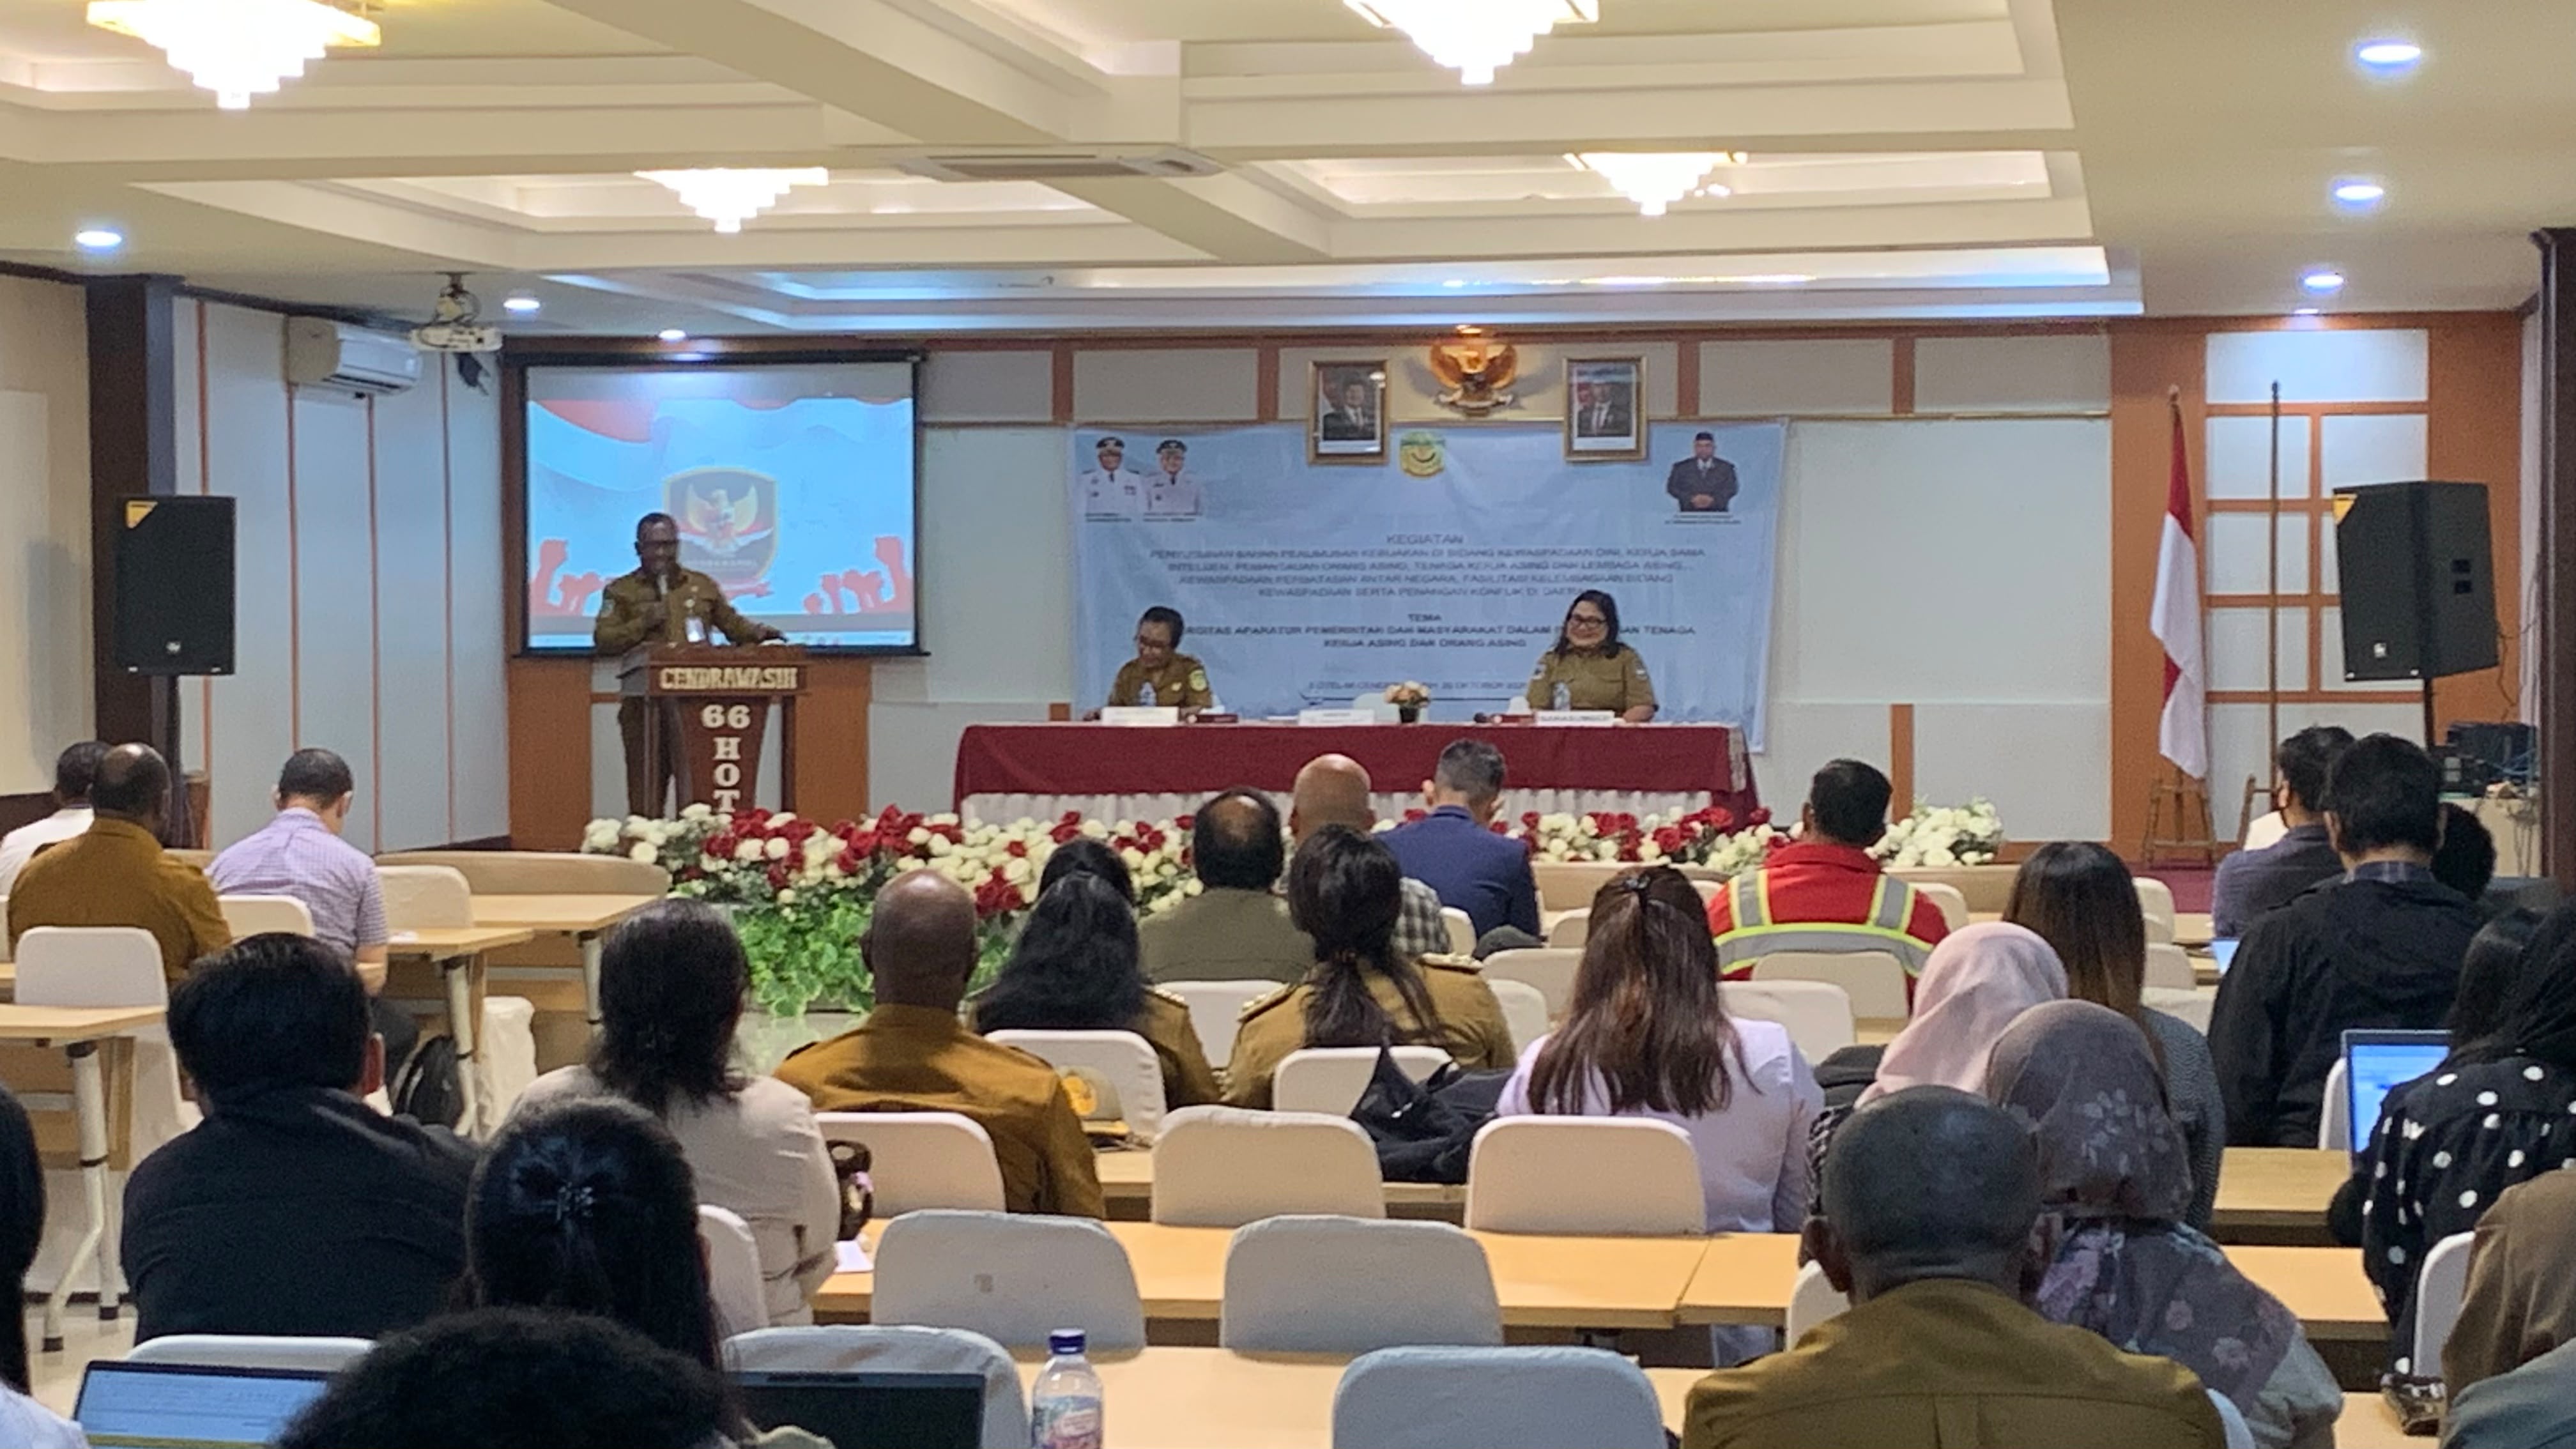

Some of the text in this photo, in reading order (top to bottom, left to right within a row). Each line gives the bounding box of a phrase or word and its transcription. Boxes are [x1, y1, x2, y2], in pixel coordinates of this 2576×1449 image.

[1386, 534, 1463, 544] KEGIATAN
[1407, 613, 1441, 622] TEMA
[1234, 625, 1302, 635] APARATUR
[1386, 625, 1414, 634] DAN
[1506, 625, 1551, 634] DALAM
[1643, 625, 1697, 635] TENAGA
[660, 668, 797, 689] CENDRAWASIH
[702, 704, 751, 729] 66
[712, 737, 741, 813] HOT
